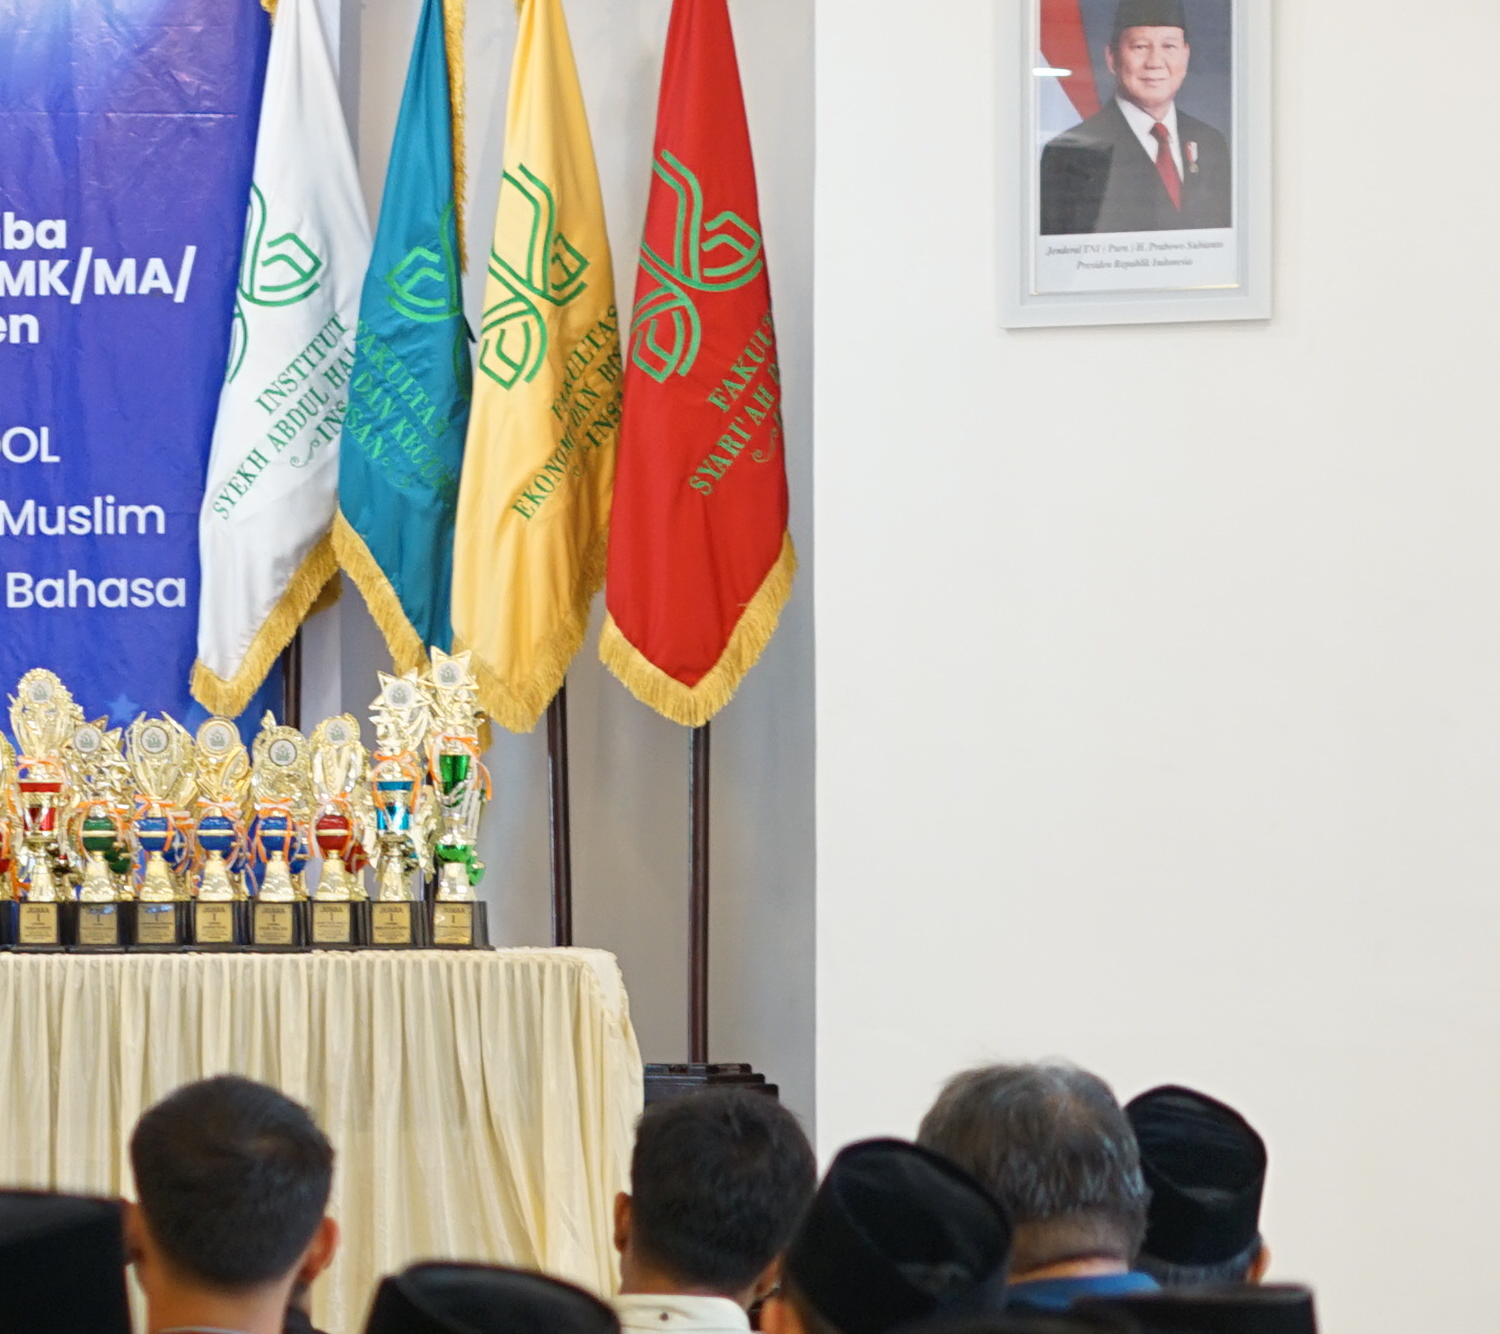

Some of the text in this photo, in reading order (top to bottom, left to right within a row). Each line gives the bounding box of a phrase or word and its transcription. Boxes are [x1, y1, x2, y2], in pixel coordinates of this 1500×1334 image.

[255, 313, 348, 416] INSTITUT
[212, 448, 271, 520] SYEKH
[267, 386, 330, 453] ABDUL
[689, 383, 775, 496] SYARI'AH
[6, 569, 186, 609] Bahasa
